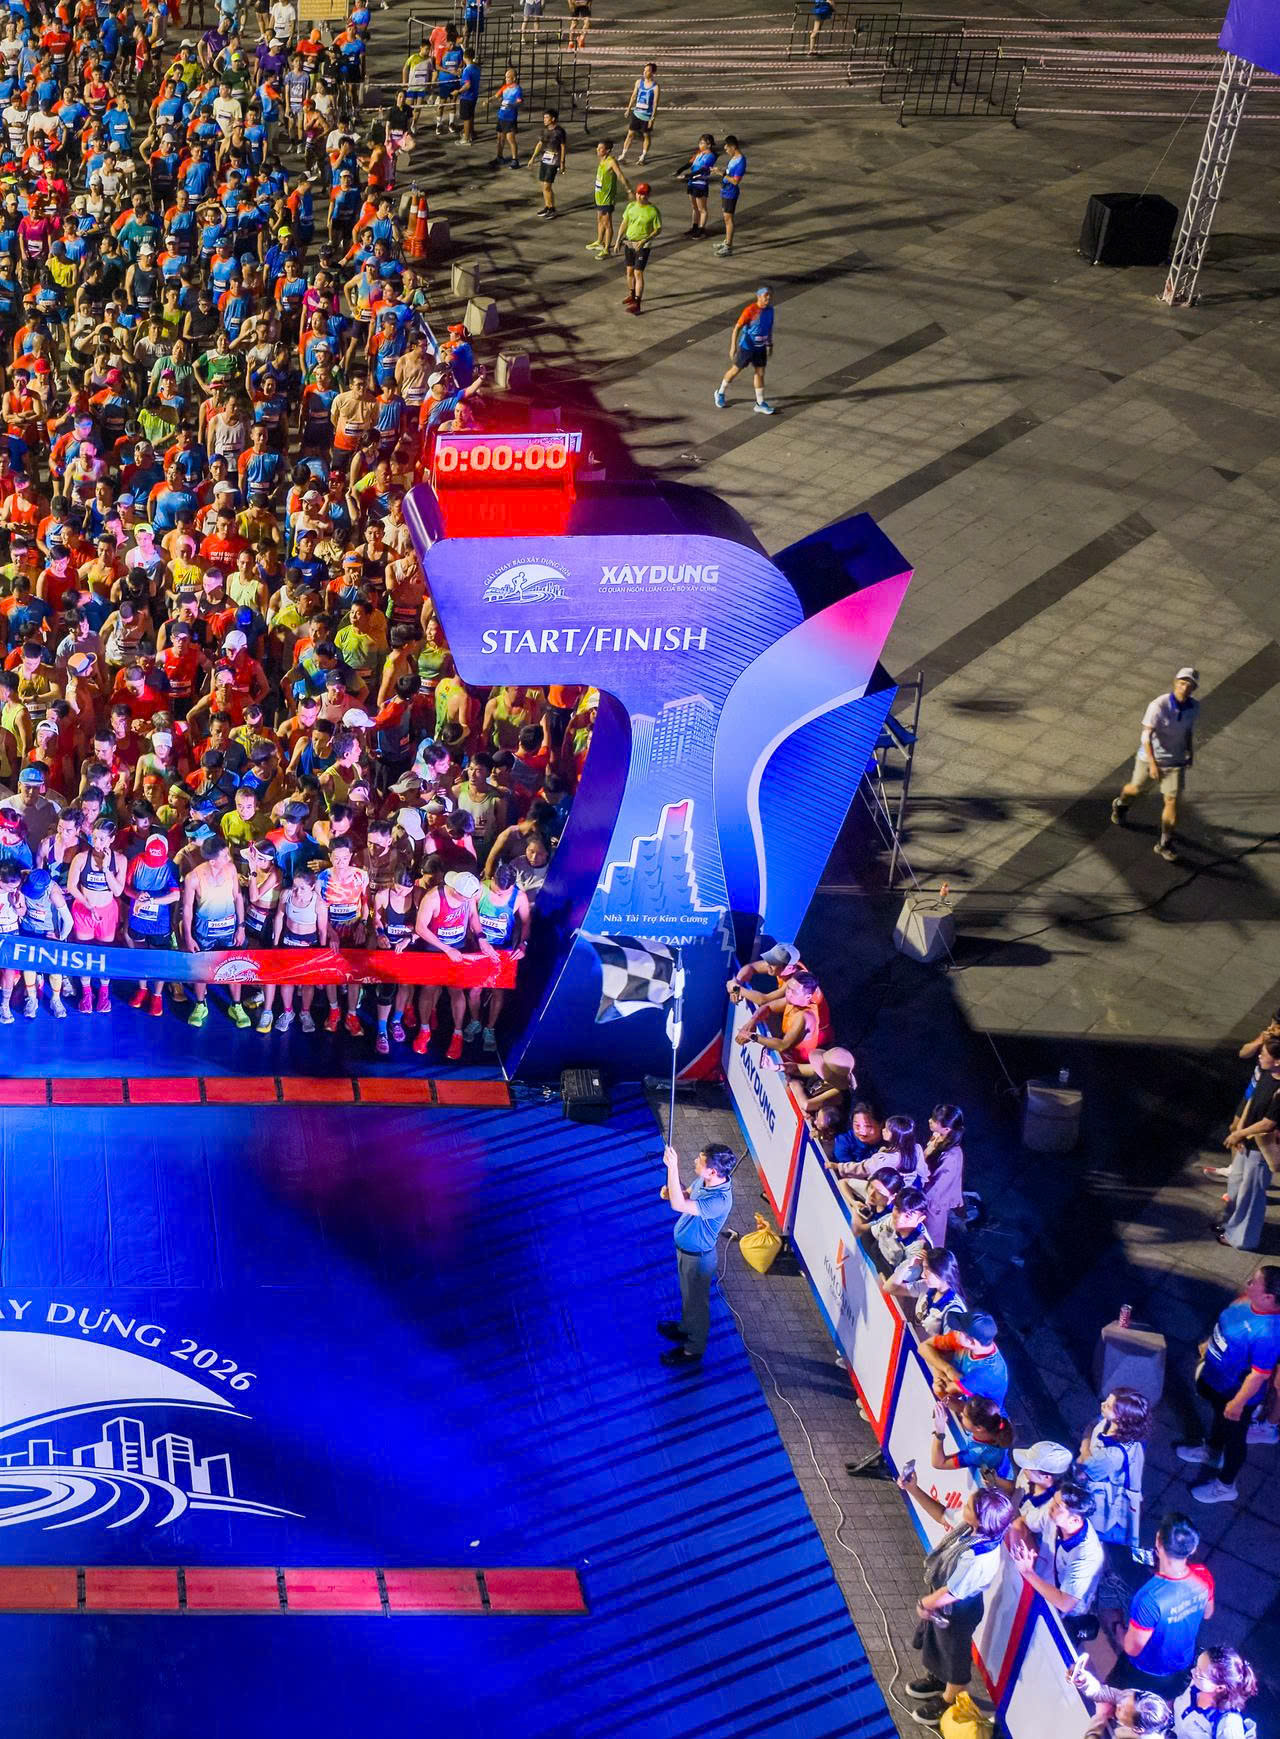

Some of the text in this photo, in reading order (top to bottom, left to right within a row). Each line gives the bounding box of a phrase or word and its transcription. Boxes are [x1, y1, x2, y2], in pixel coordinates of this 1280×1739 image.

[437, 444, 567, 472] 0:00:00
[480, 627, 708, 656] START/FINISH
[603, 914, 709, 924] Nhà Tài Trợ Kim Cương
[13, 943, 106, 973] FINISH
[46, 1302, 167, 1347] DỰNG
[169, 1338, 257, 1391] 2026
